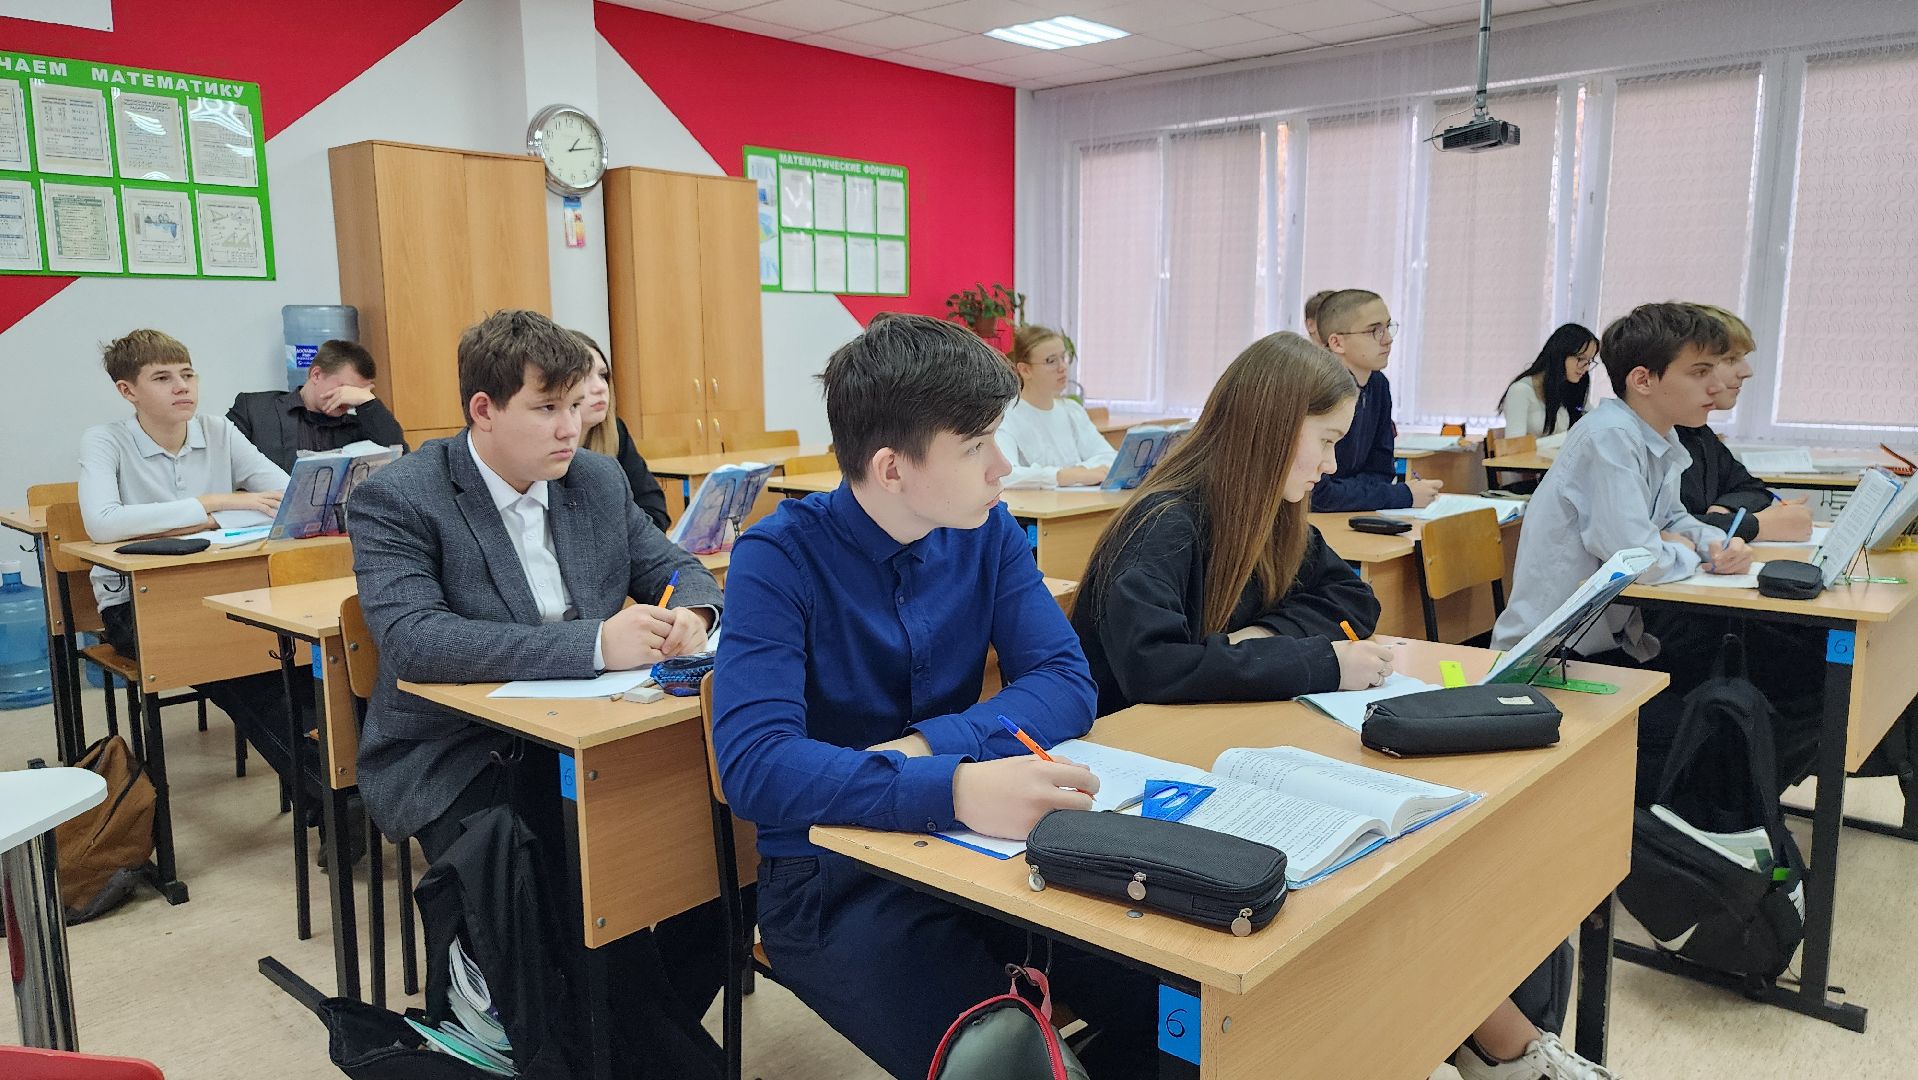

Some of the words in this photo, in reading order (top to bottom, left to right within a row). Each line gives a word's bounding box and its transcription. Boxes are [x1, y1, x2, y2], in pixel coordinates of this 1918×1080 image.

[91, 67, 245, 98] МАТЕМАТИКУ
[779, 153, 861, 173] МАТЕМАТИЧЕСКИЕ
[863, 165, 904, 178] ФОРМУЛЫ
[1834, 638, 1848, 654] 6
[564, 768, 574, 786] 6
[1166, 1008, 1188, 1039] 6
